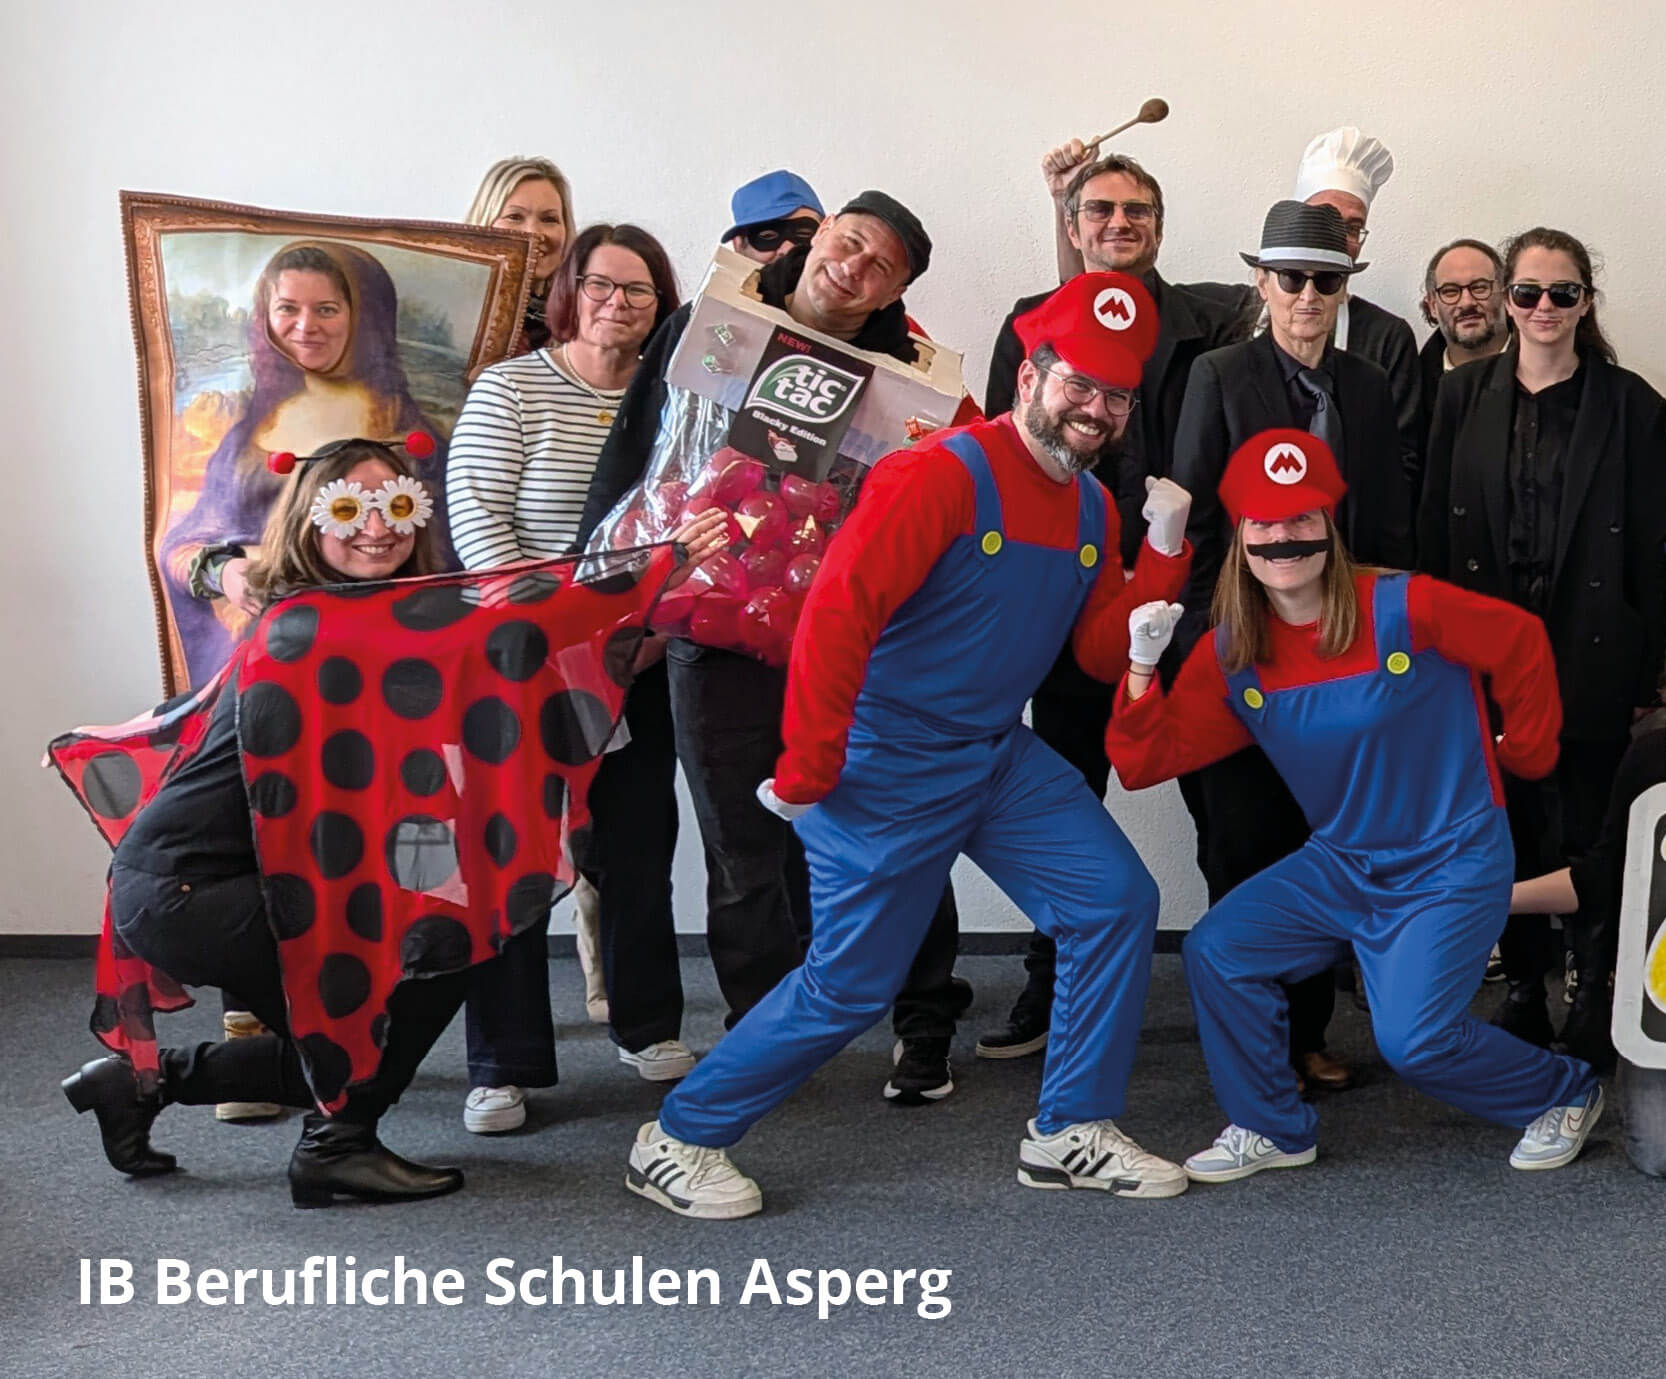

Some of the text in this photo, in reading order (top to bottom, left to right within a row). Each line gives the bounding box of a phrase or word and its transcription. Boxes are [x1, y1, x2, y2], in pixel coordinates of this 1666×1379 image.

[1097, 295, 1131, 323] M
[777, 333, 811, 353] NEW!
[774, 377, 833, 416] tac
[795, 364, 842, 399] tic
[751, 410, 828, 447] Blacky Edition
[1269, 450, 1303, 476] M
